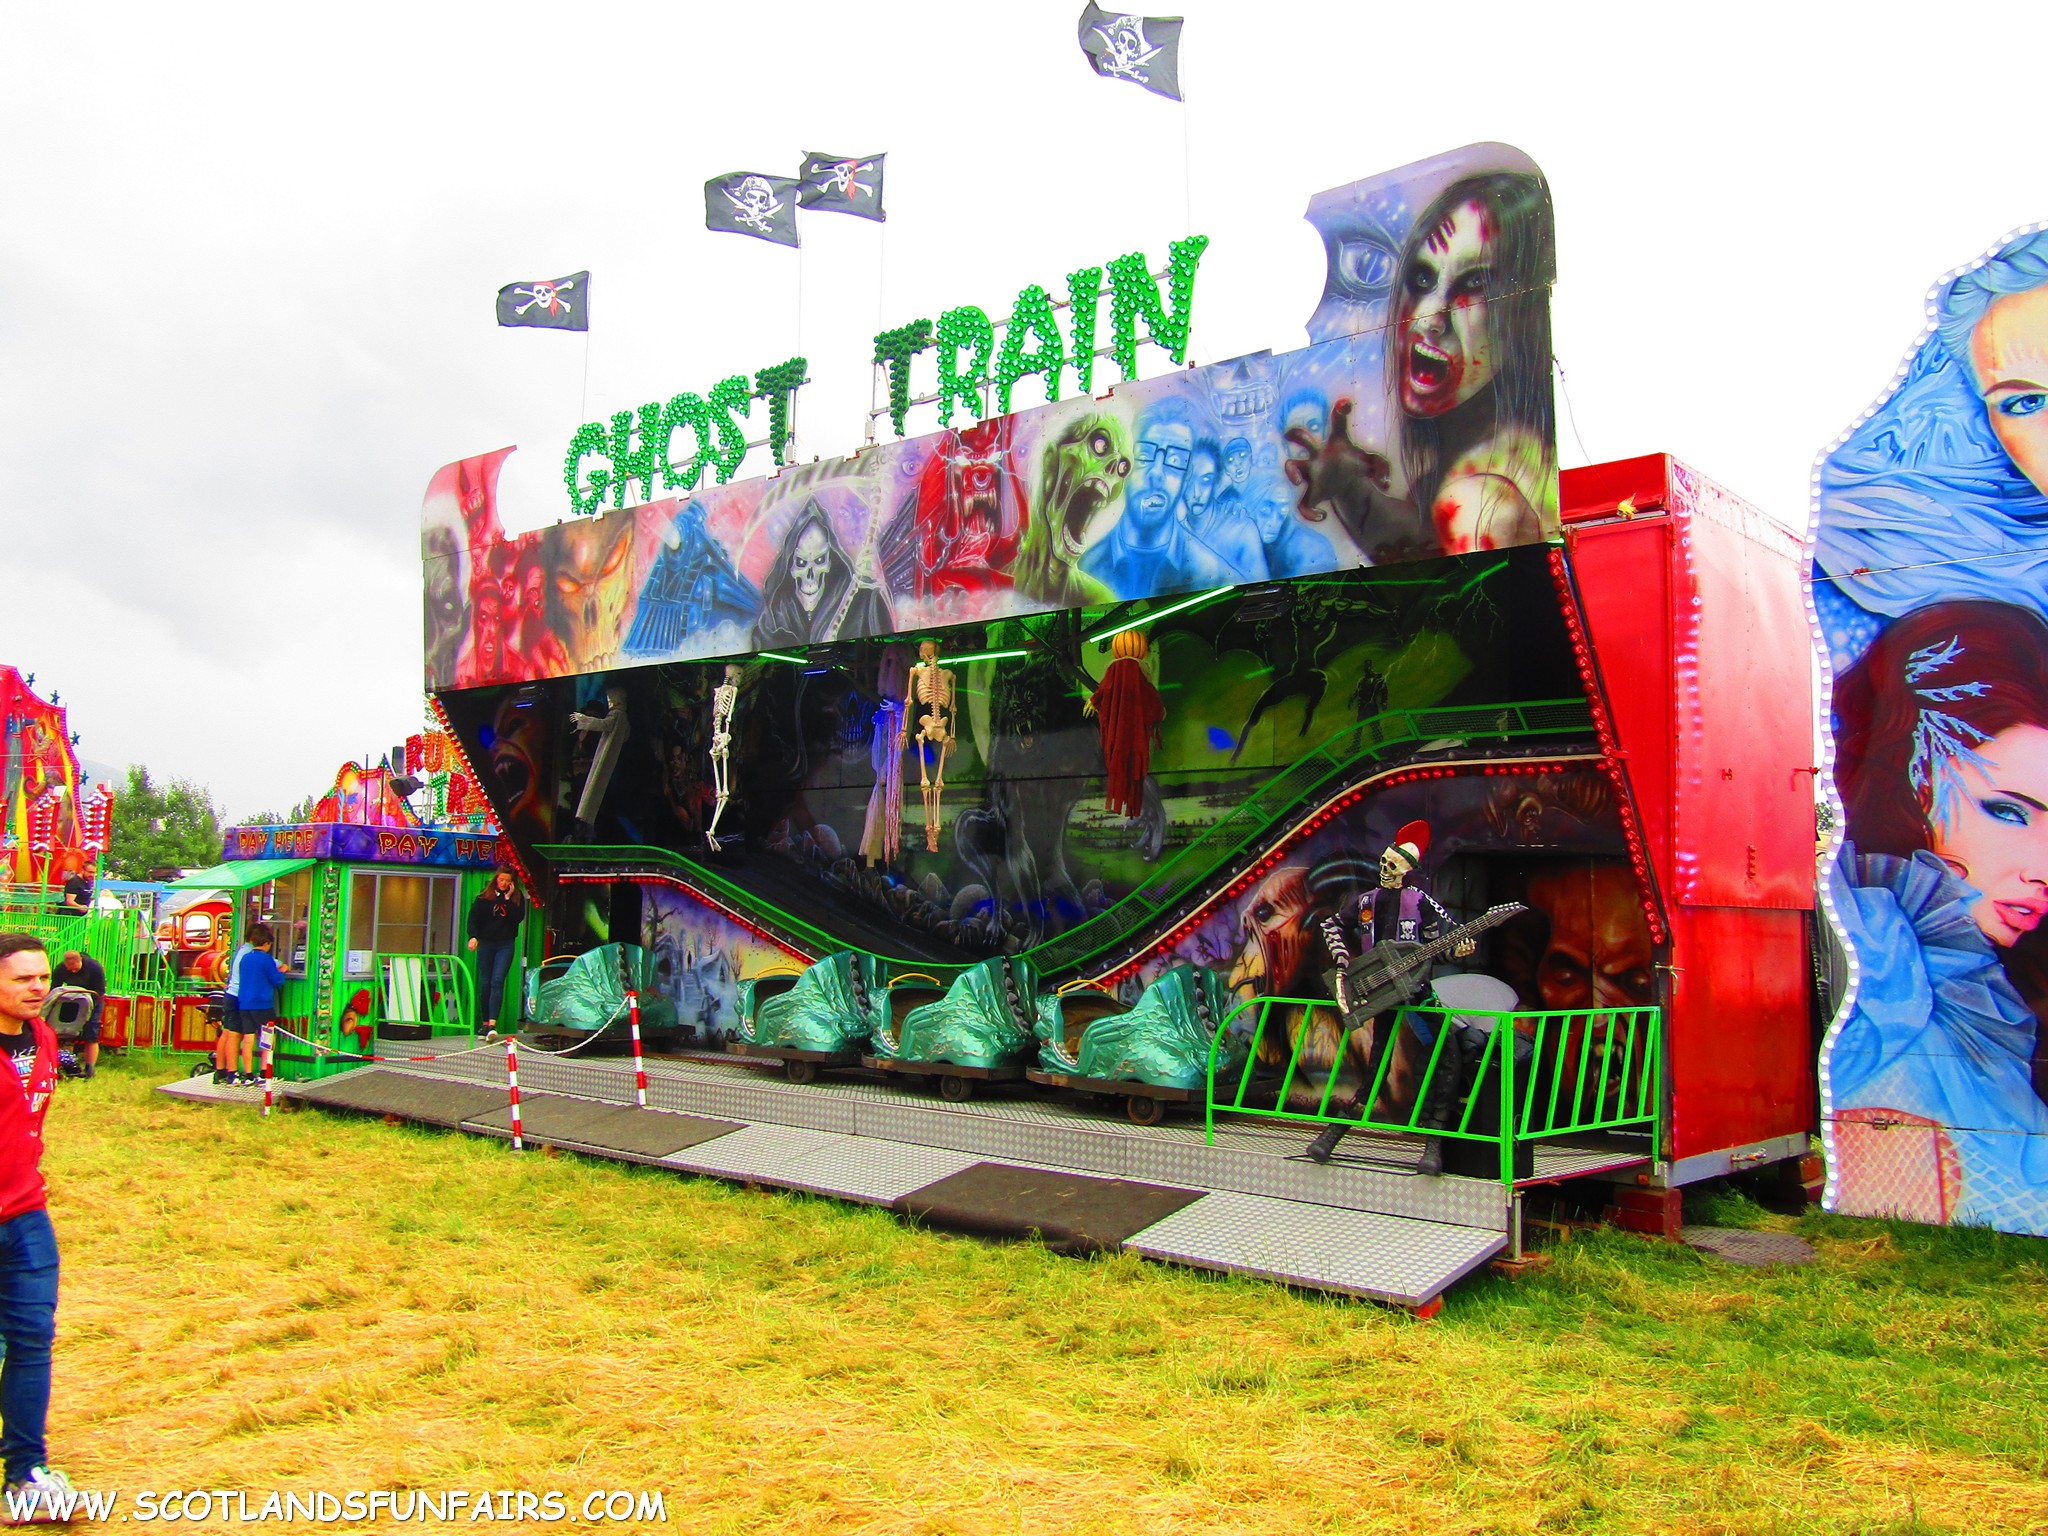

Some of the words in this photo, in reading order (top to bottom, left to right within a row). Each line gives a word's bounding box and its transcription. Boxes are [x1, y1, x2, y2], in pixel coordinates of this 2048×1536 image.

[564, 356, 808, 516] GHOST
[872, 235, 1209, 438] TRAIN
[430, 771, 487, 816] TRA
[239, 832, 269, 854] PAY
[274, 829, 314, 854] HERE
[378, 832, 438, 858] PAY
[455, 838, 509, 862] HER
